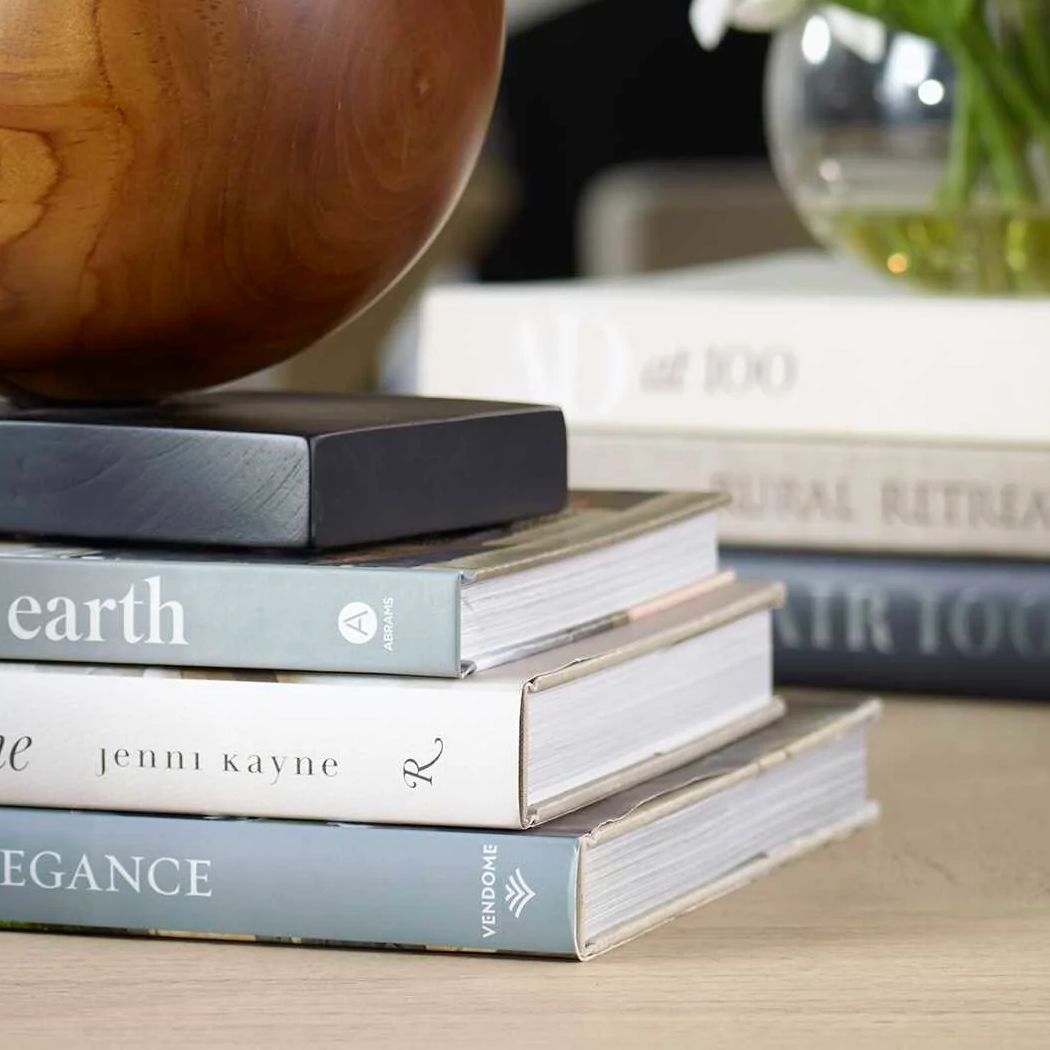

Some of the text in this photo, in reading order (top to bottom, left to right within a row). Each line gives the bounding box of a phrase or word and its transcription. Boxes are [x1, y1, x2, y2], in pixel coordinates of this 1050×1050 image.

[704, 344, 800, 397] 100
[7, 575, 189, 645] earth
[383, 597, 394, 652] ABRAMS
[481, 843, 498, 939] VENDOME
